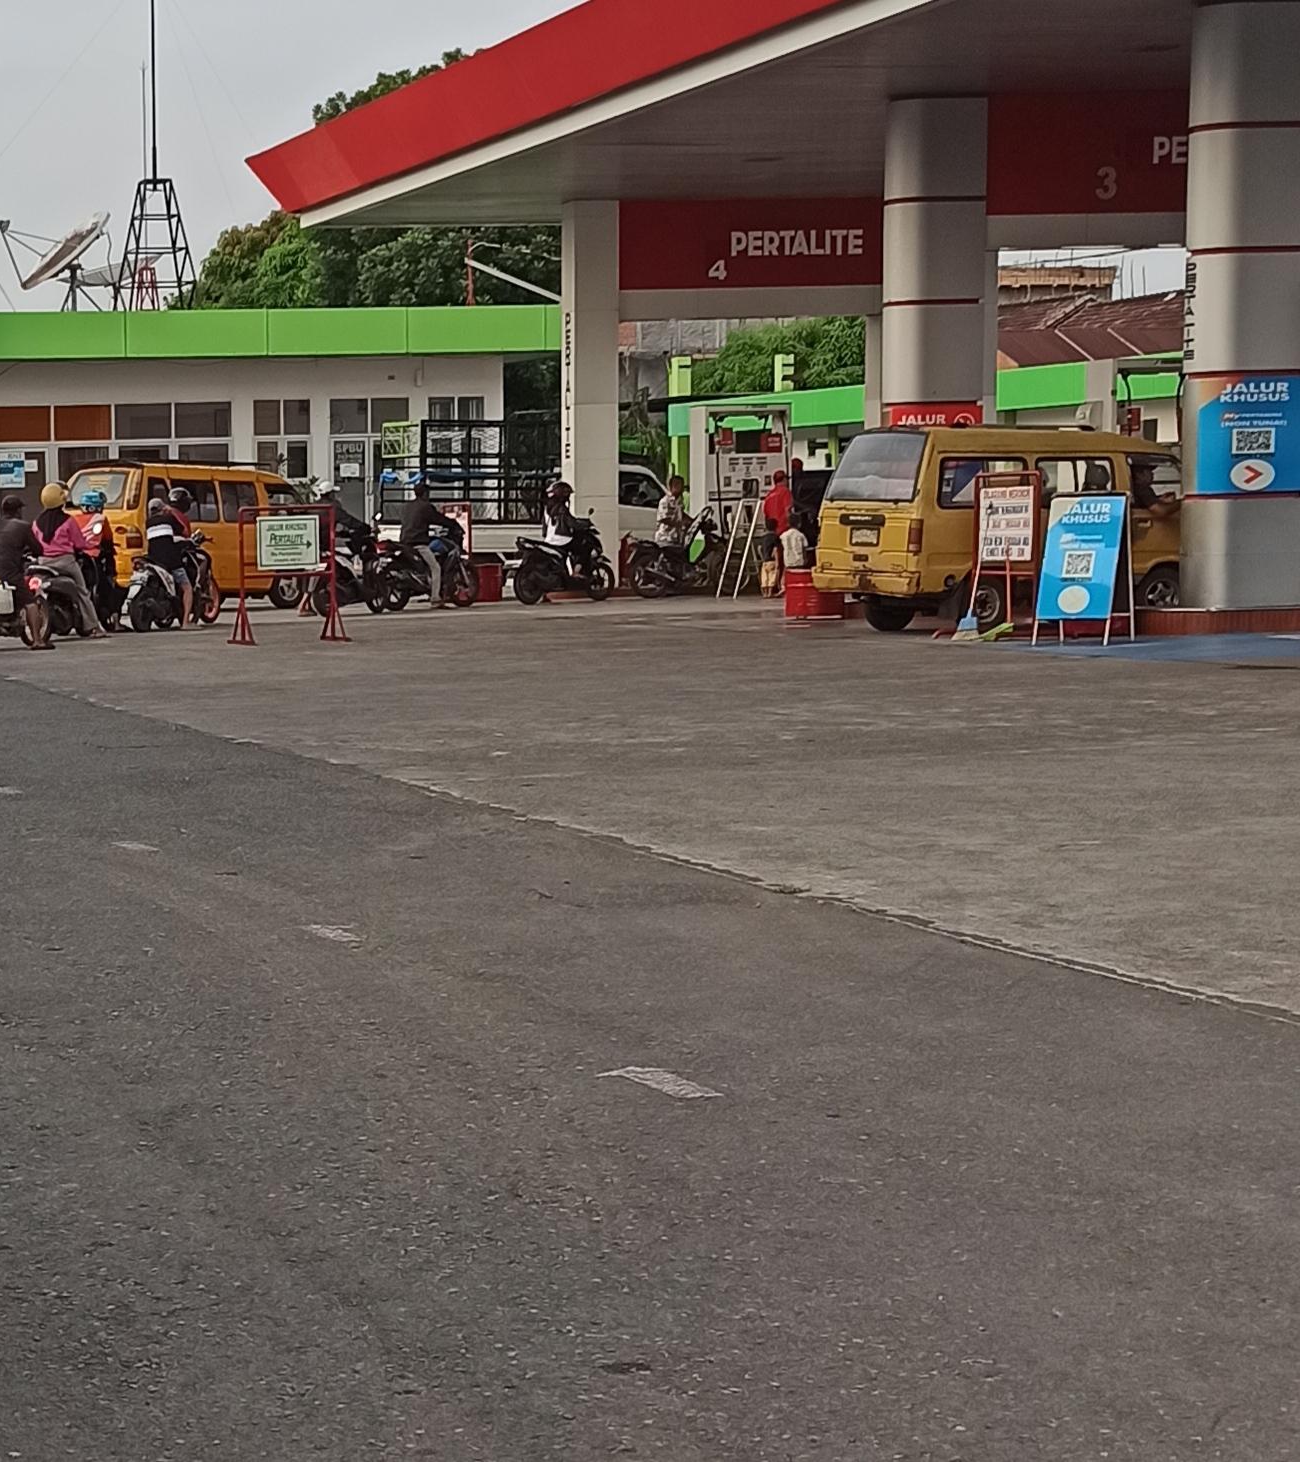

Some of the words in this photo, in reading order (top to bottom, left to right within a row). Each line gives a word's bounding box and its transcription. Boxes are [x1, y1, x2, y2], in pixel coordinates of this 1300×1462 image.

[1152, 135, 1188, 165] PE
[1095, 166, 1118, 200] 3
[730, 229, 864, 257] PERTALITE
[708, 259, 728, 280] 4
[1221, 382, 1290, 394] JALUR
[1220, 393, 1290, 403] KHUSUS
[897, 414, 946, 426] JALUR
[1061, 514, 1112, 524] KHUSUS
